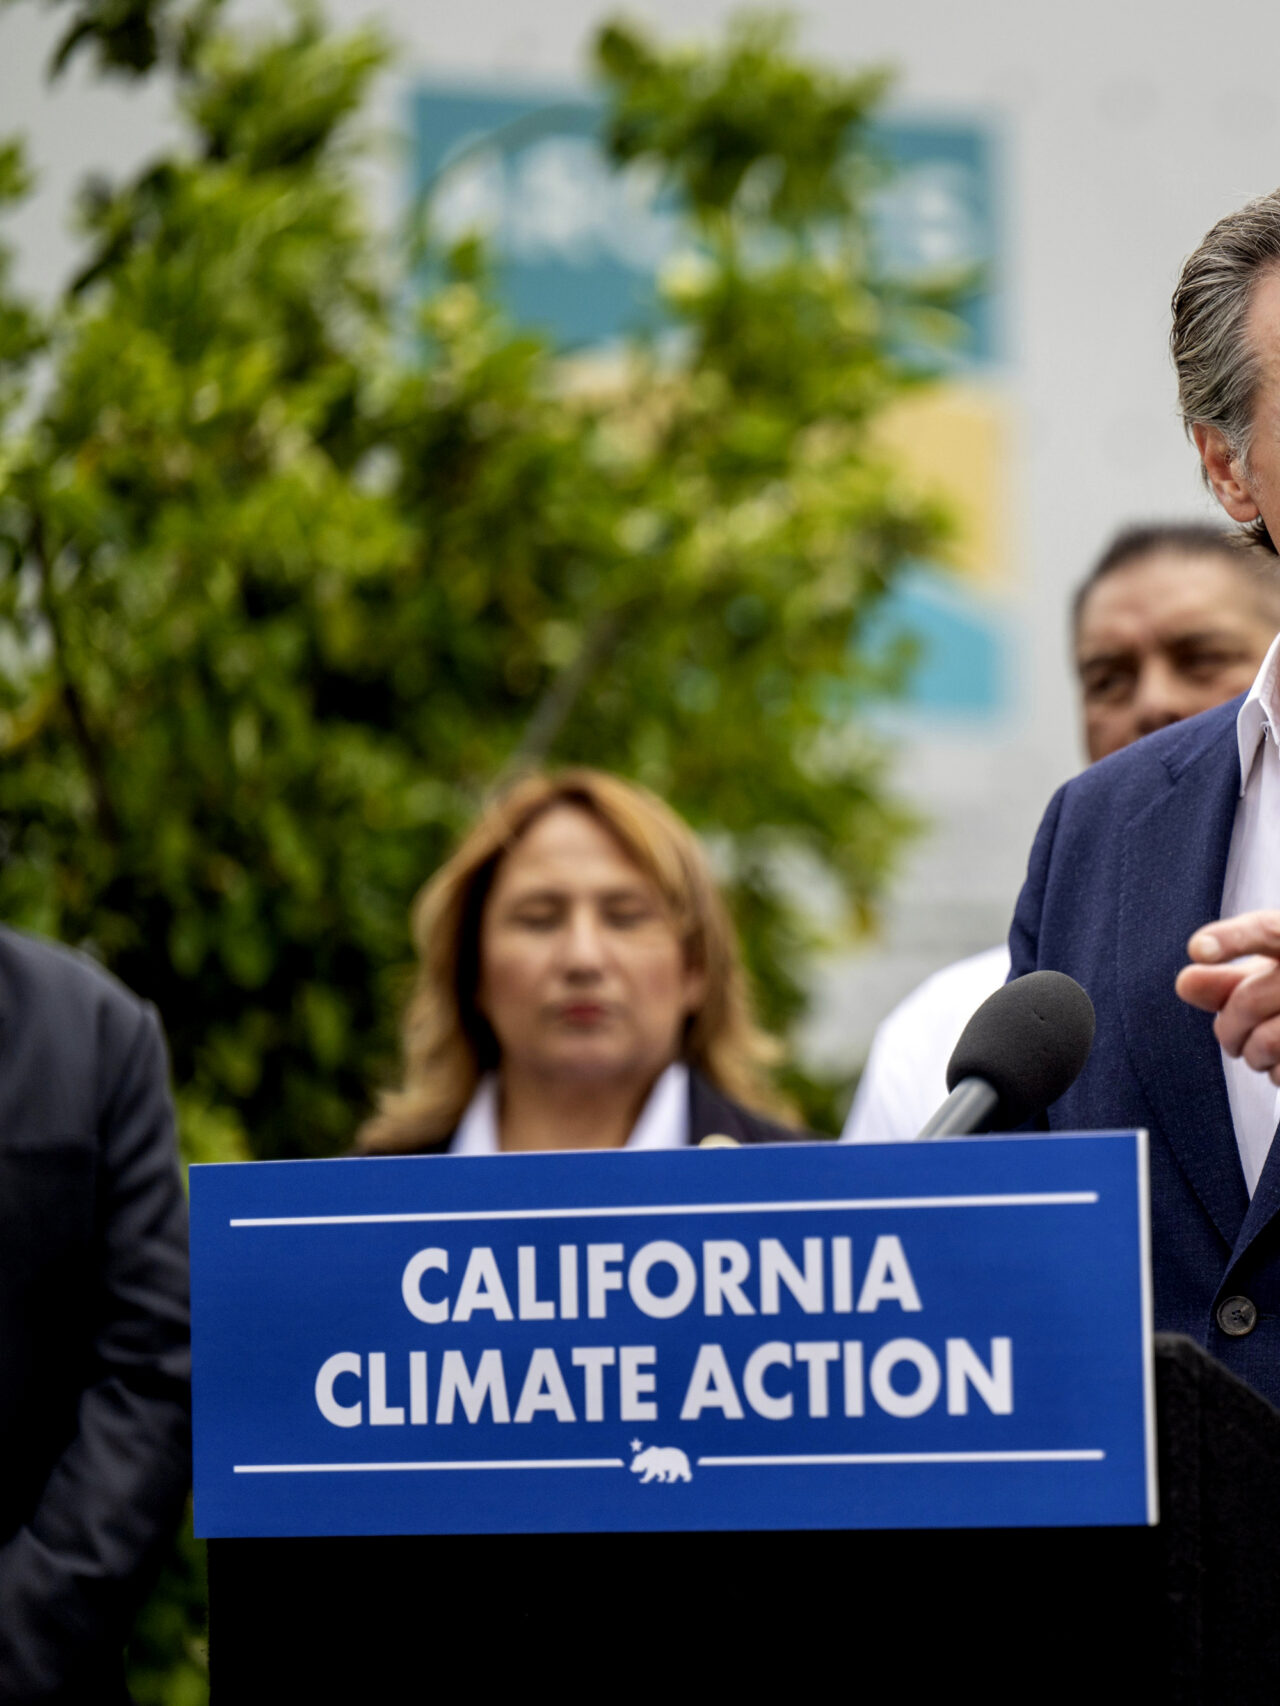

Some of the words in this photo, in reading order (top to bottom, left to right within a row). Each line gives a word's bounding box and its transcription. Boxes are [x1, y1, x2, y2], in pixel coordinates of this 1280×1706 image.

[401, 1235, 922, 1324] CALIFORNIA
[315, 1345, 657, 1428] CLIMATE
[680, 1337, 1013, 1420] ACTION
